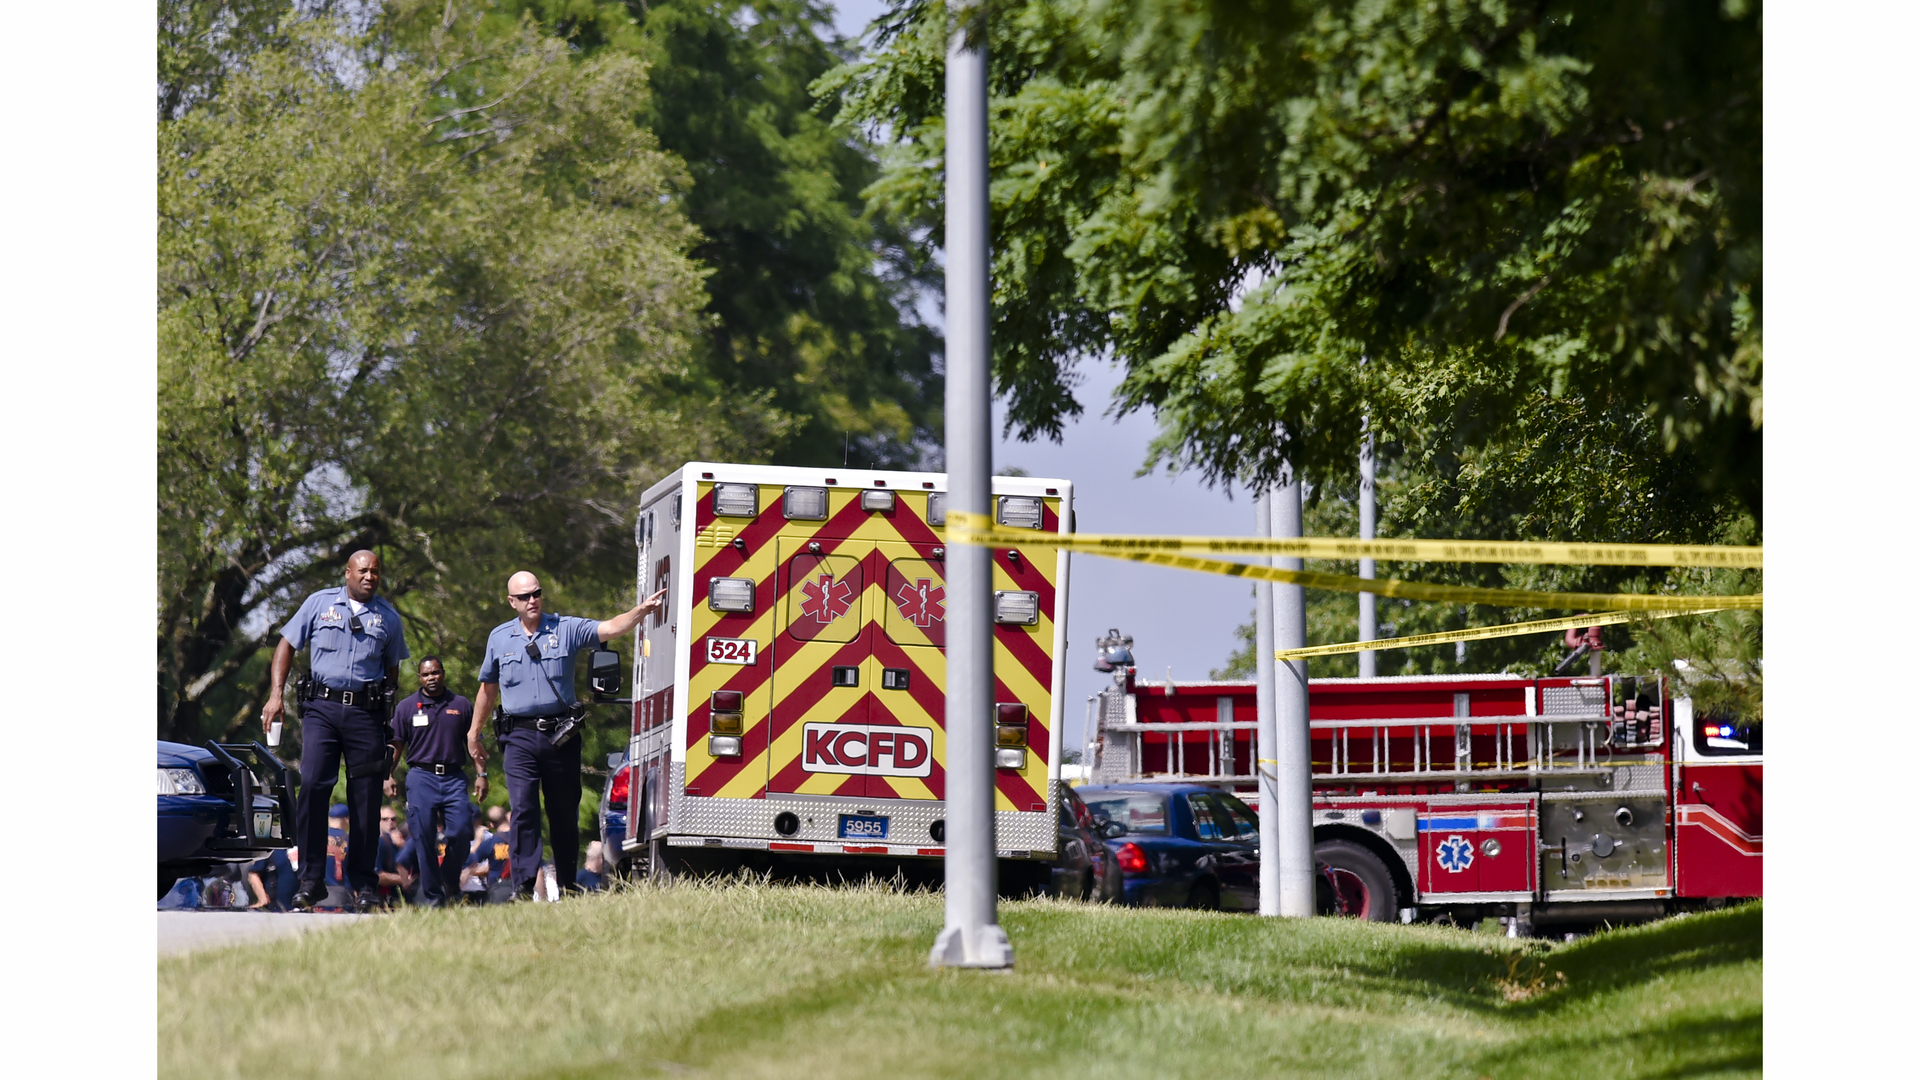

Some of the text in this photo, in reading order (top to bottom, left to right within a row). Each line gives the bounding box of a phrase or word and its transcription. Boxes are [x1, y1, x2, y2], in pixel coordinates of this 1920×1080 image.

[710, 641, 751, 661] 524
[805, 729, 928, 769] KCFD
[845, 820, 882, 833] 5955
